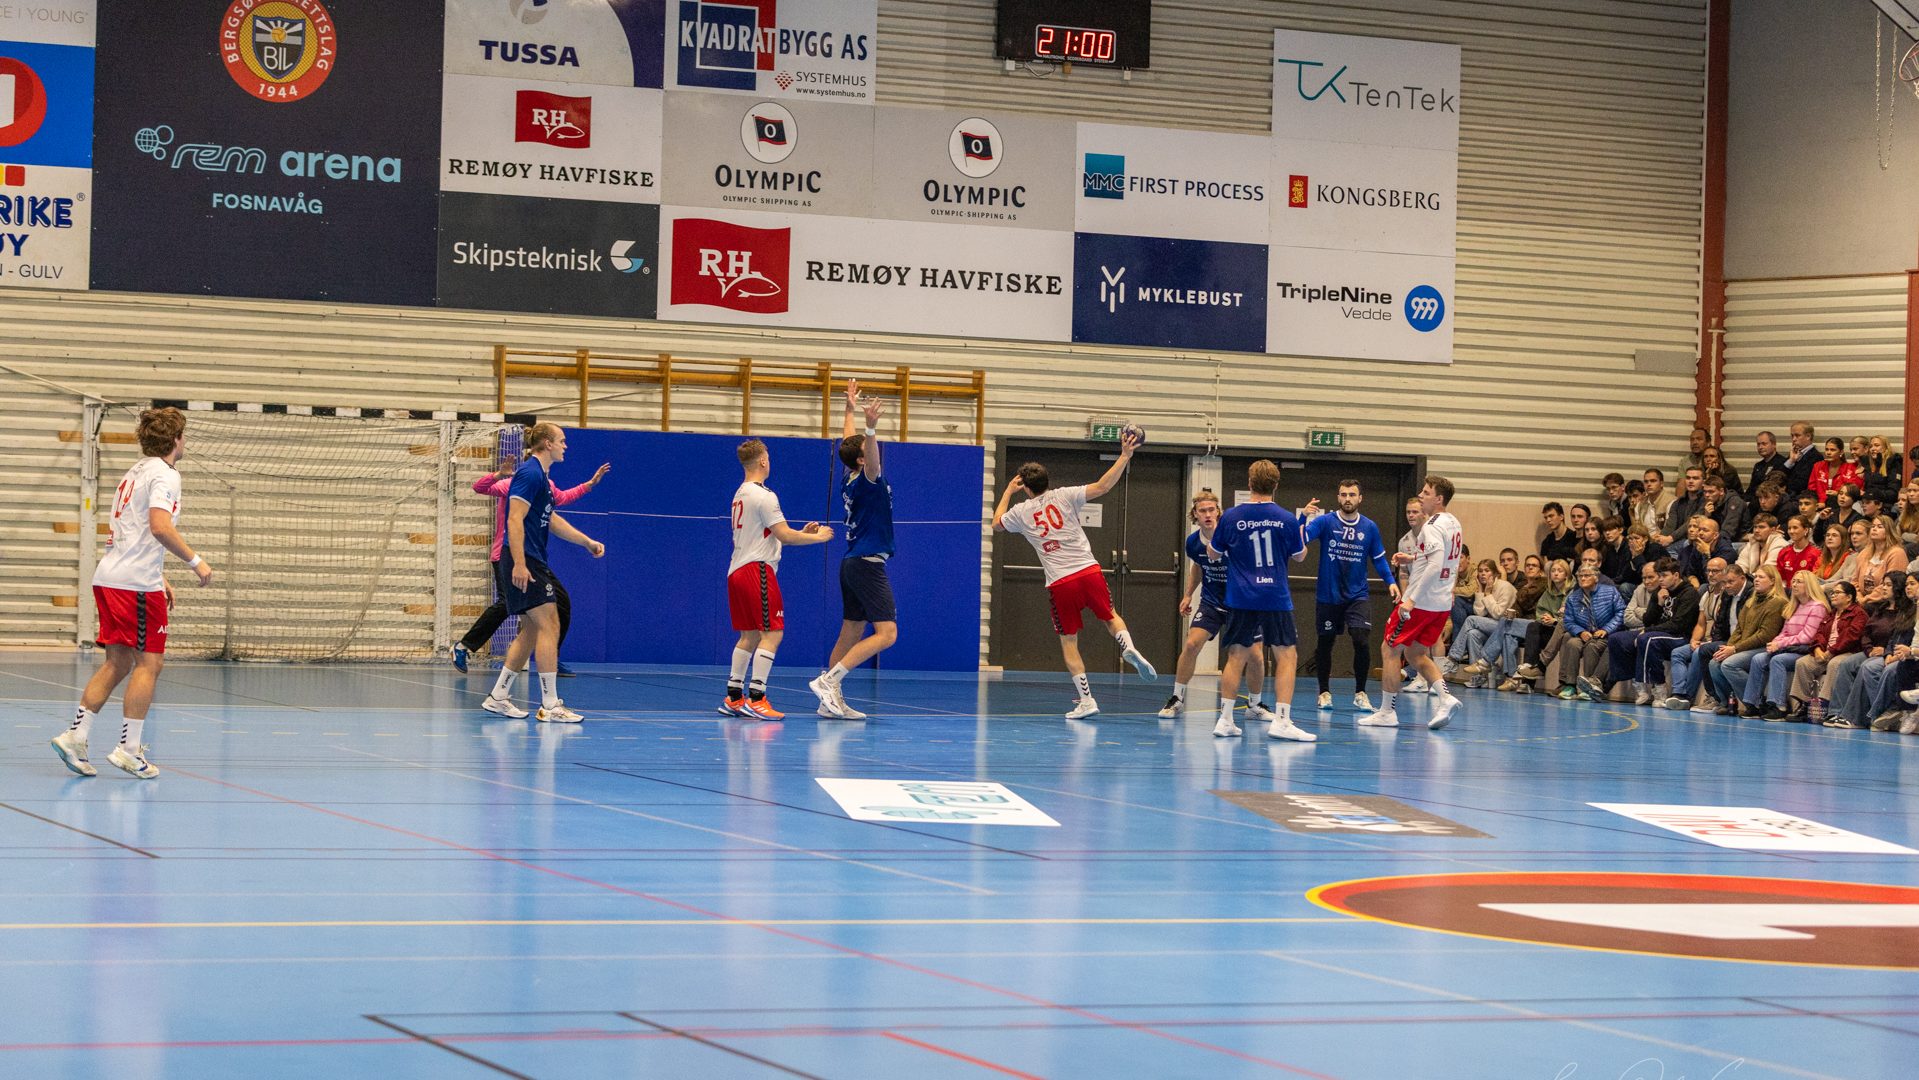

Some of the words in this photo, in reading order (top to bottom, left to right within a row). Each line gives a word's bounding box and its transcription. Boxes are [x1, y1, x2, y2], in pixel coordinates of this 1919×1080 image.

[479, 39, 580, 68] TUSSA
[841, 33, 868, 61] AS
[1038, 28, 1113, 59] 21:00
[264, 46, 293, 71] BIL
[258, 83, 298, 98] 1944
[796, 71, 867, 87] SYSTEMHUS
[796, 87, 867, 98] www.systemhus.no
[1349, 81, 1455, 113] TenTek
[532, 108, 567, 126] RH
[765, 123, 777, 139] O
[971, 139, 983, 154] O
[280, 150, 401, 183] arena
[449, 158, 533, 179] REMØY
[539, 164, 654, 187] HAVFISKE
[715, 164, 822, 193] OLYMPIC
[923, 179, 1026, 208] OLYMPIC
[1083, 172, 1126, 192] MMC
[1130, 176, 1179, 195] FIRST
[1185, 181, 1264, 201] PROCESS
[1317, 184, 1440, 210] KONGSBERG
[212, 192, 324, 214] FOSNAVÅG
[722, 195, 758, 204] OLYMPIC
[760, 197, 800, 206] SHIPPING
[453, 241, 602, 272] Skipsteknisk
[19, 264, 63, 279] GULV
[699, 248, 753, 278] RH
[806, 260, 911, 286] REMØY
[920, 267, 1063, 295] HAVFISKE
[1138, 287, 1243, 307] MYKLEBUST
[1277, 282, 1392, 304] TripleNine
[1341, 306, 1392, 321] Vedde
[1411, 297, 1439, 320] 999
[1033, 503, 1064, 538] 50
[1247, 520, 1284, 529] Fjordkraft
[1342, 526, 1355, 541] 73
[1447, 532, 1461, 560] 18
[1249, 529, 1274, 567] 11
